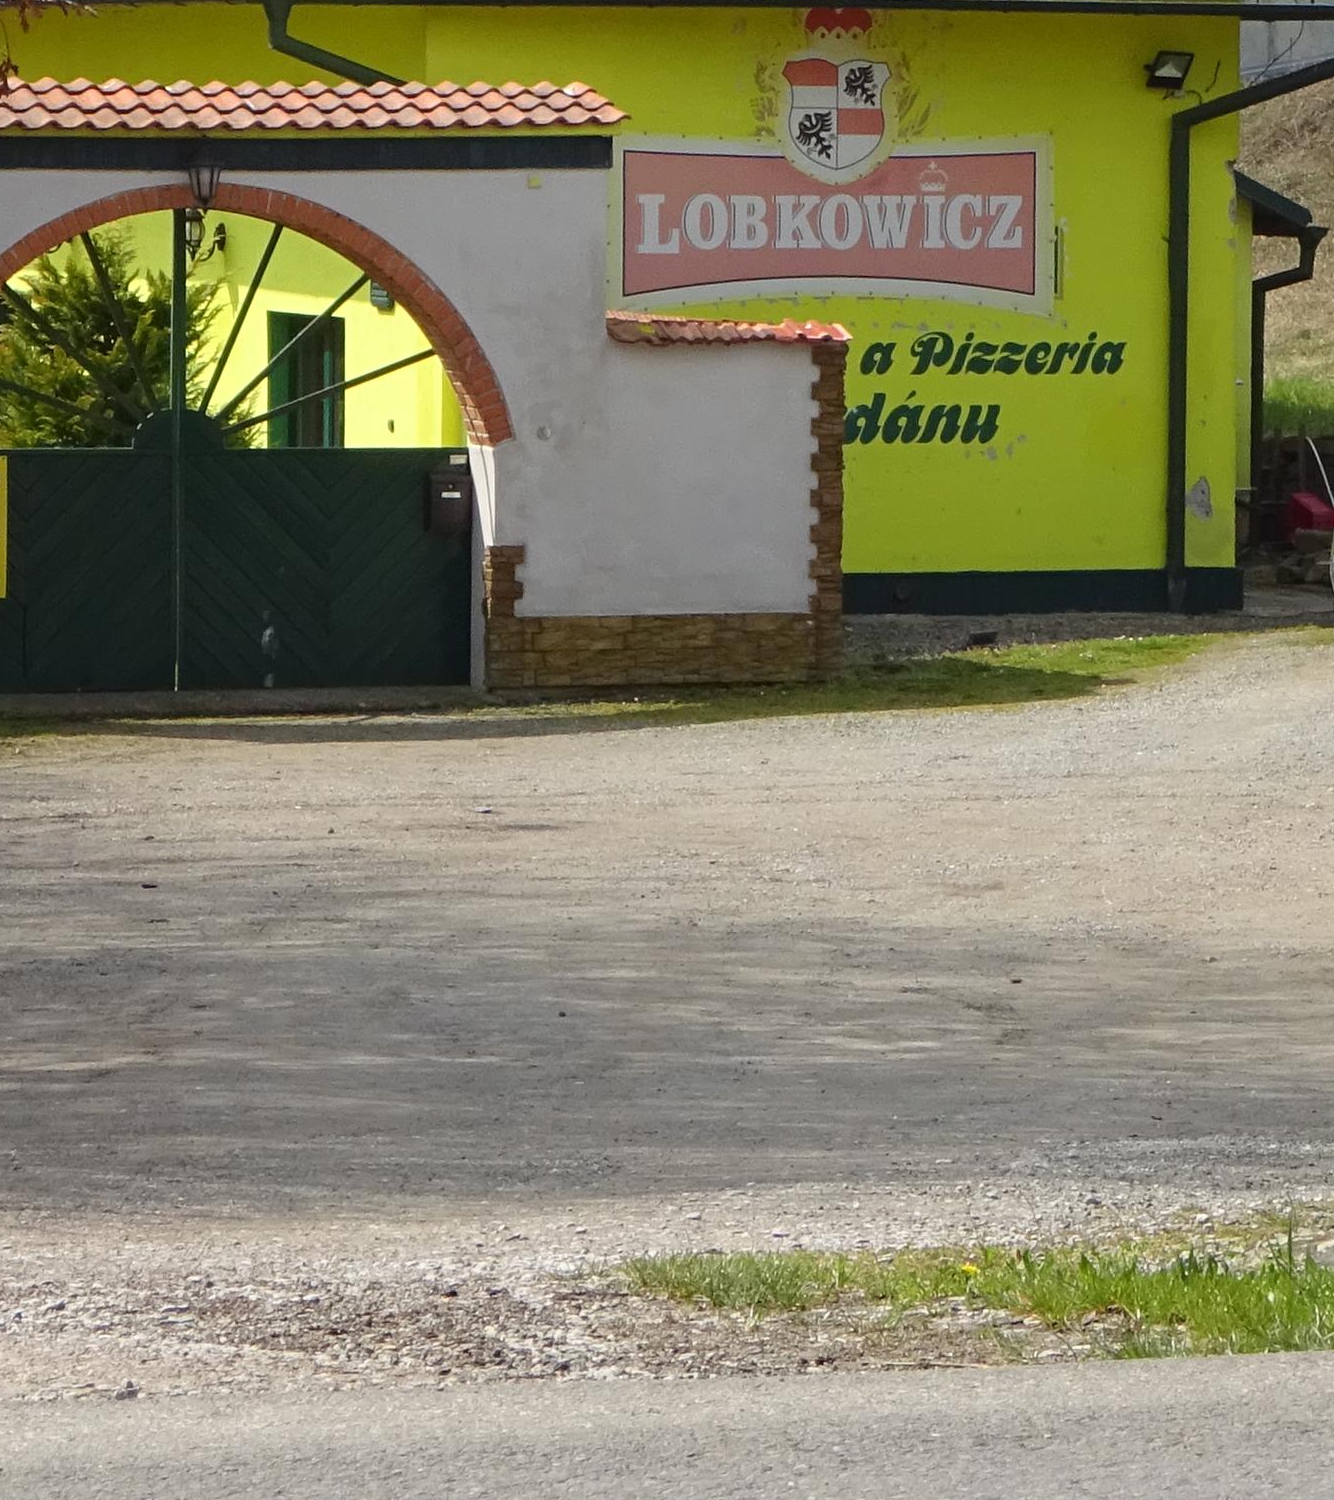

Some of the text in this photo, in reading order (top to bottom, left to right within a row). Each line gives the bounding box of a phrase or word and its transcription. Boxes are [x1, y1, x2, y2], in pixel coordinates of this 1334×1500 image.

[636, 193, 1023, 254] LOBKOWICZ
[860, 331, 1127, 375] a Pizzeria
[843, 391, 1000, 444] dánu
